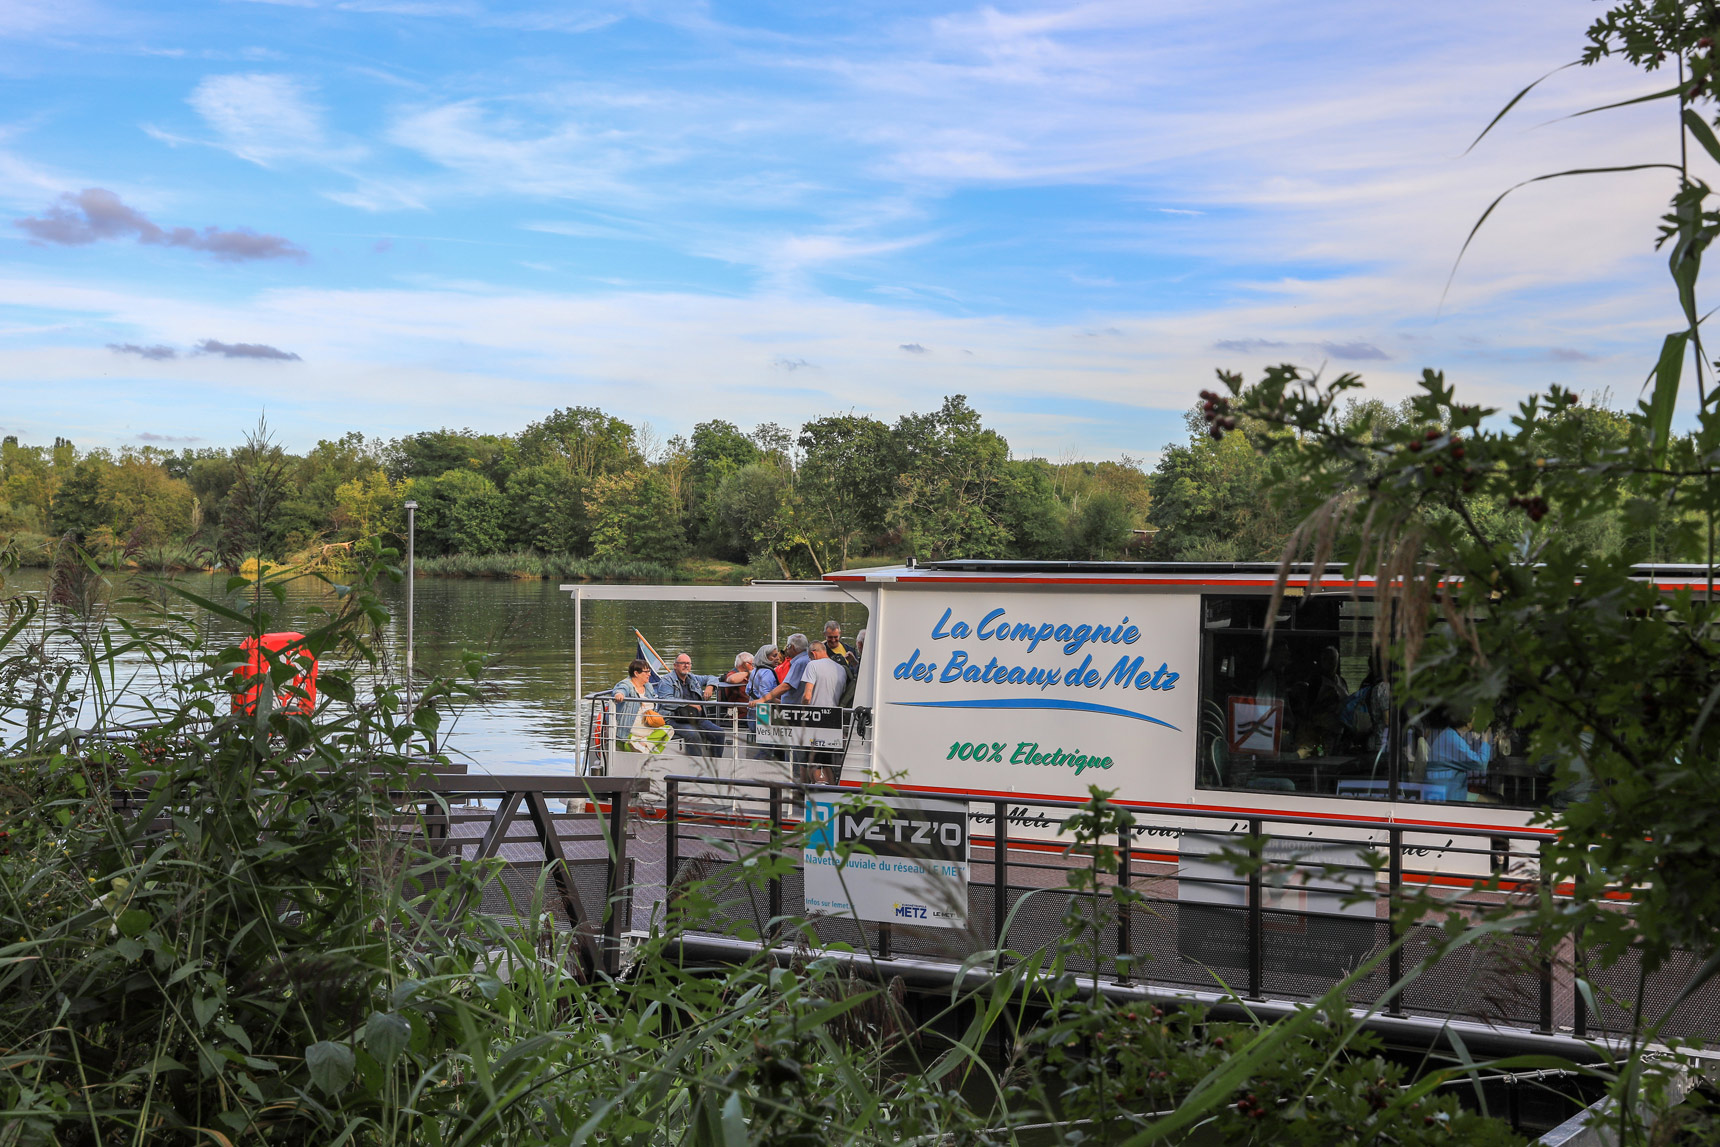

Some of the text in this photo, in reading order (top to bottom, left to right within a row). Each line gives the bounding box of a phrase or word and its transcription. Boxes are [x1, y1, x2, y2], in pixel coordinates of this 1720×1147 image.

[931, 607, 1141, 655] La Compagnie
[893, 648, 1181, 691] des Bateaux de Metz
[774, 710, 821, 721] METZ'O
[773, 728, 792, 737] METZ
[946, 741, 1114, 776] 100% Electrique
[844, 815, 962, 847] METZ'O
[879, 861, 891, 871] du
[893, 862, 925, 874] réseau
[805, 898, 820, 906] Infos
[896, 907, 927, 919] METZ
